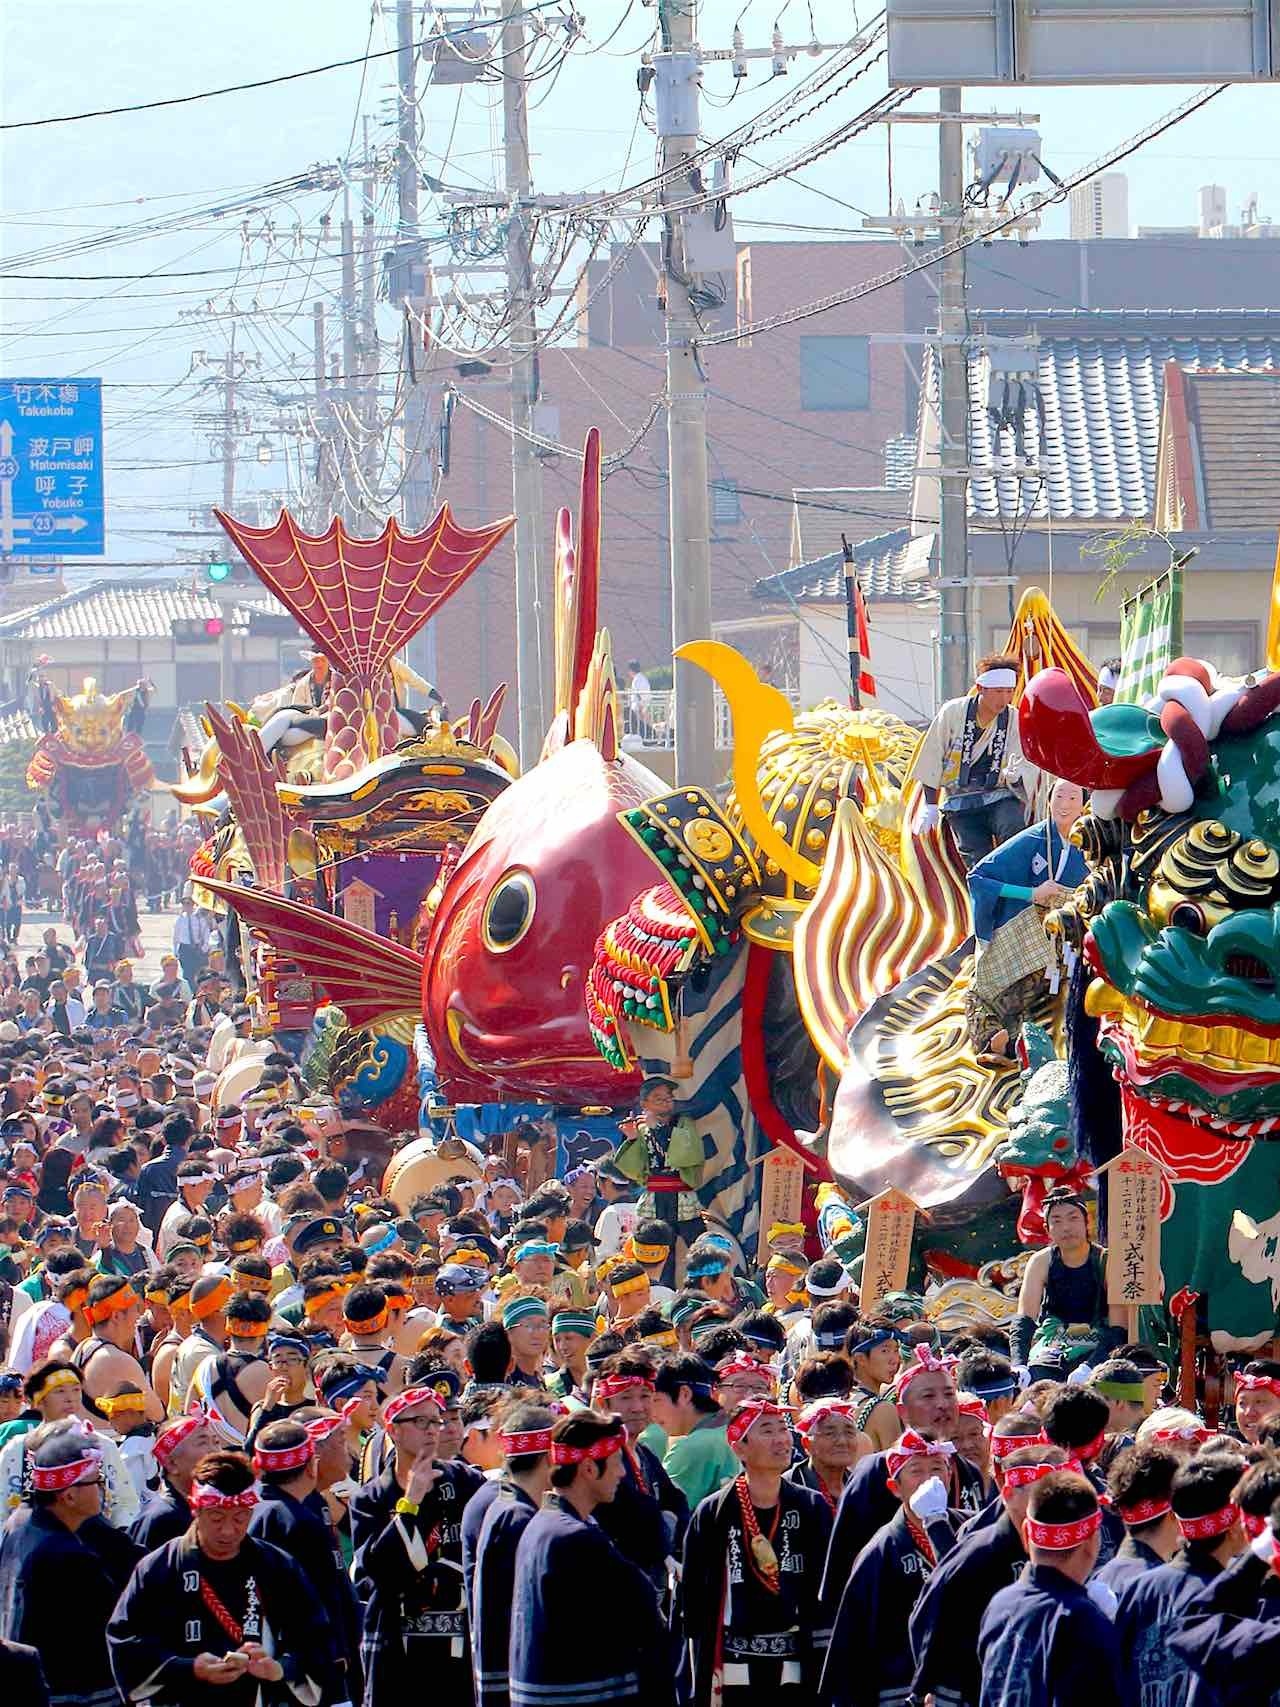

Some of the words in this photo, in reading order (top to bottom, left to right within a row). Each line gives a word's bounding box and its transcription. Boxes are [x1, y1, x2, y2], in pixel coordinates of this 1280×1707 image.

[29, 437, 94, 457] 波戸岬
[35, 476, 88, 496] 呼子
[1122, 1242, 1145, 1300] 式年祭
